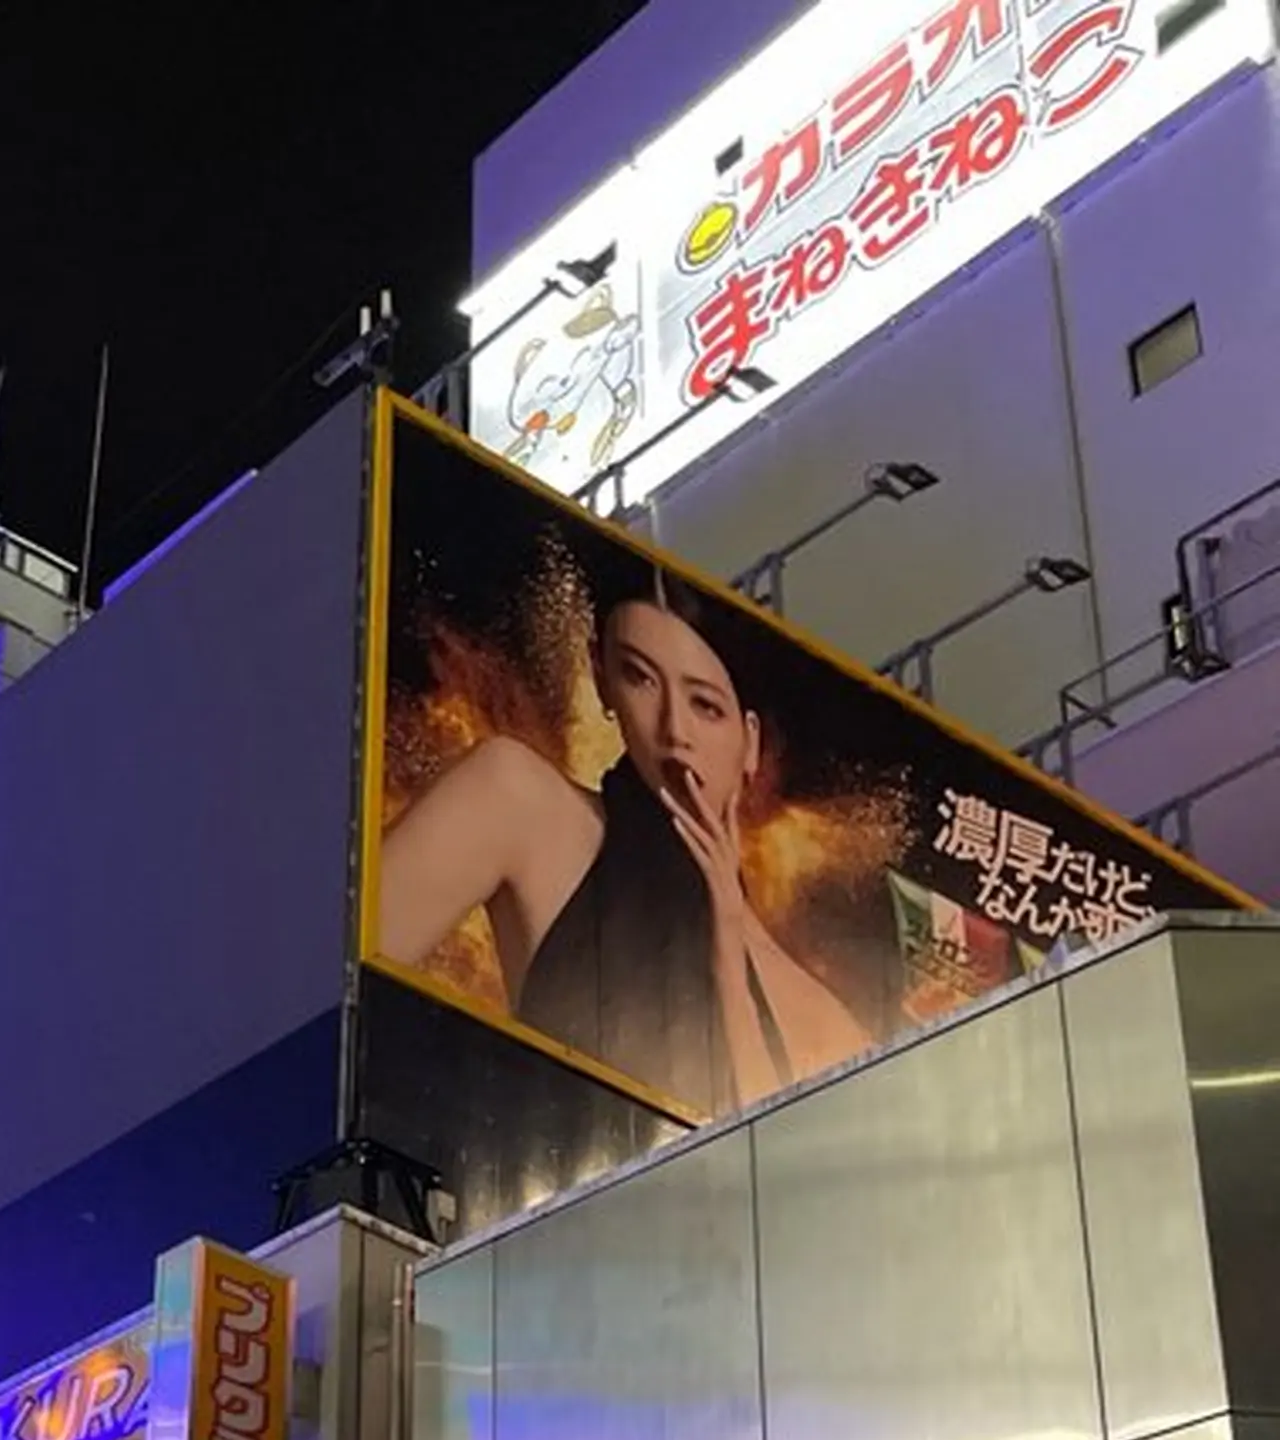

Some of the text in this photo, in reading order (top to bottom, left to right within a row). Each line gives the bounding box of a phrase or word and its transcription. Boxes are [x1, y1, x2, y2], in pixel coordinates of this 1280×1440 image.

[687, 5, 1132, 400] まねきねこ
